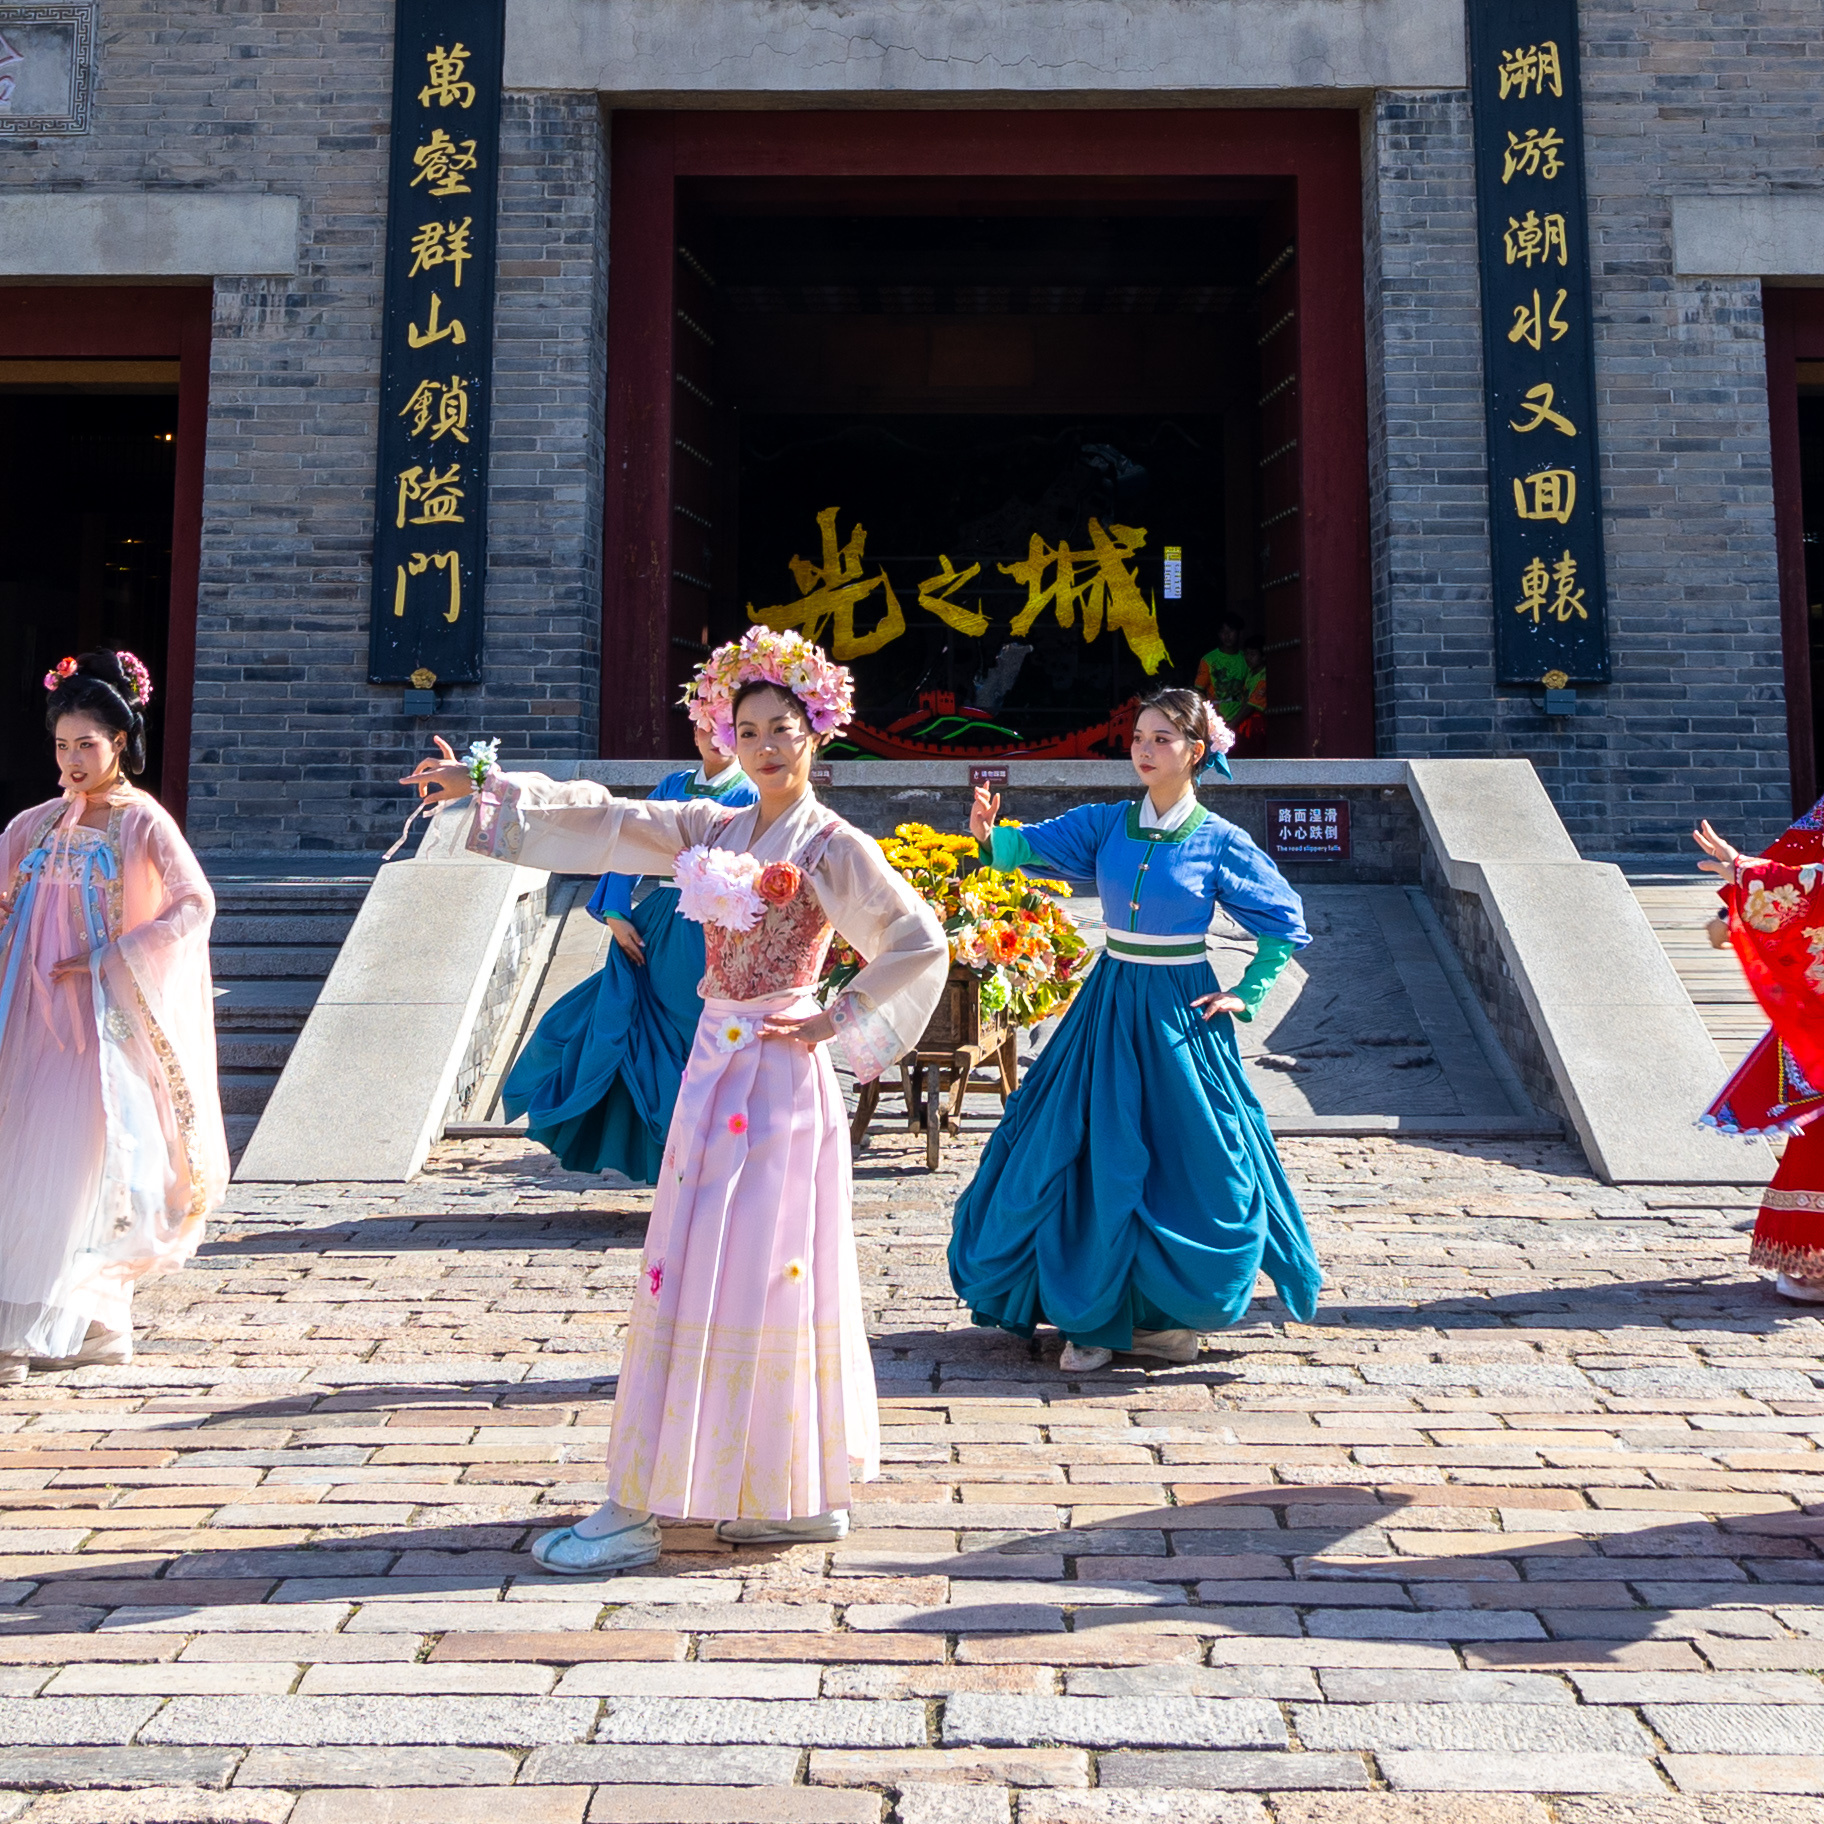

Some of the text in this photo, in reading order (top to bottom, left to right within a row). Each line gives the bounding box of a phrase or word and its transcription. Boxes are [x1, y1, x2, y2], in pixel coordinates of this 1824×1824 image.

[747, 507, 1175, 675] 光之城
[1278, 808, 1338, 823] 路面湿滑
[1279, 826, 1338, 840] 小心跌倒
[1276, 844, 1288, 852] The
